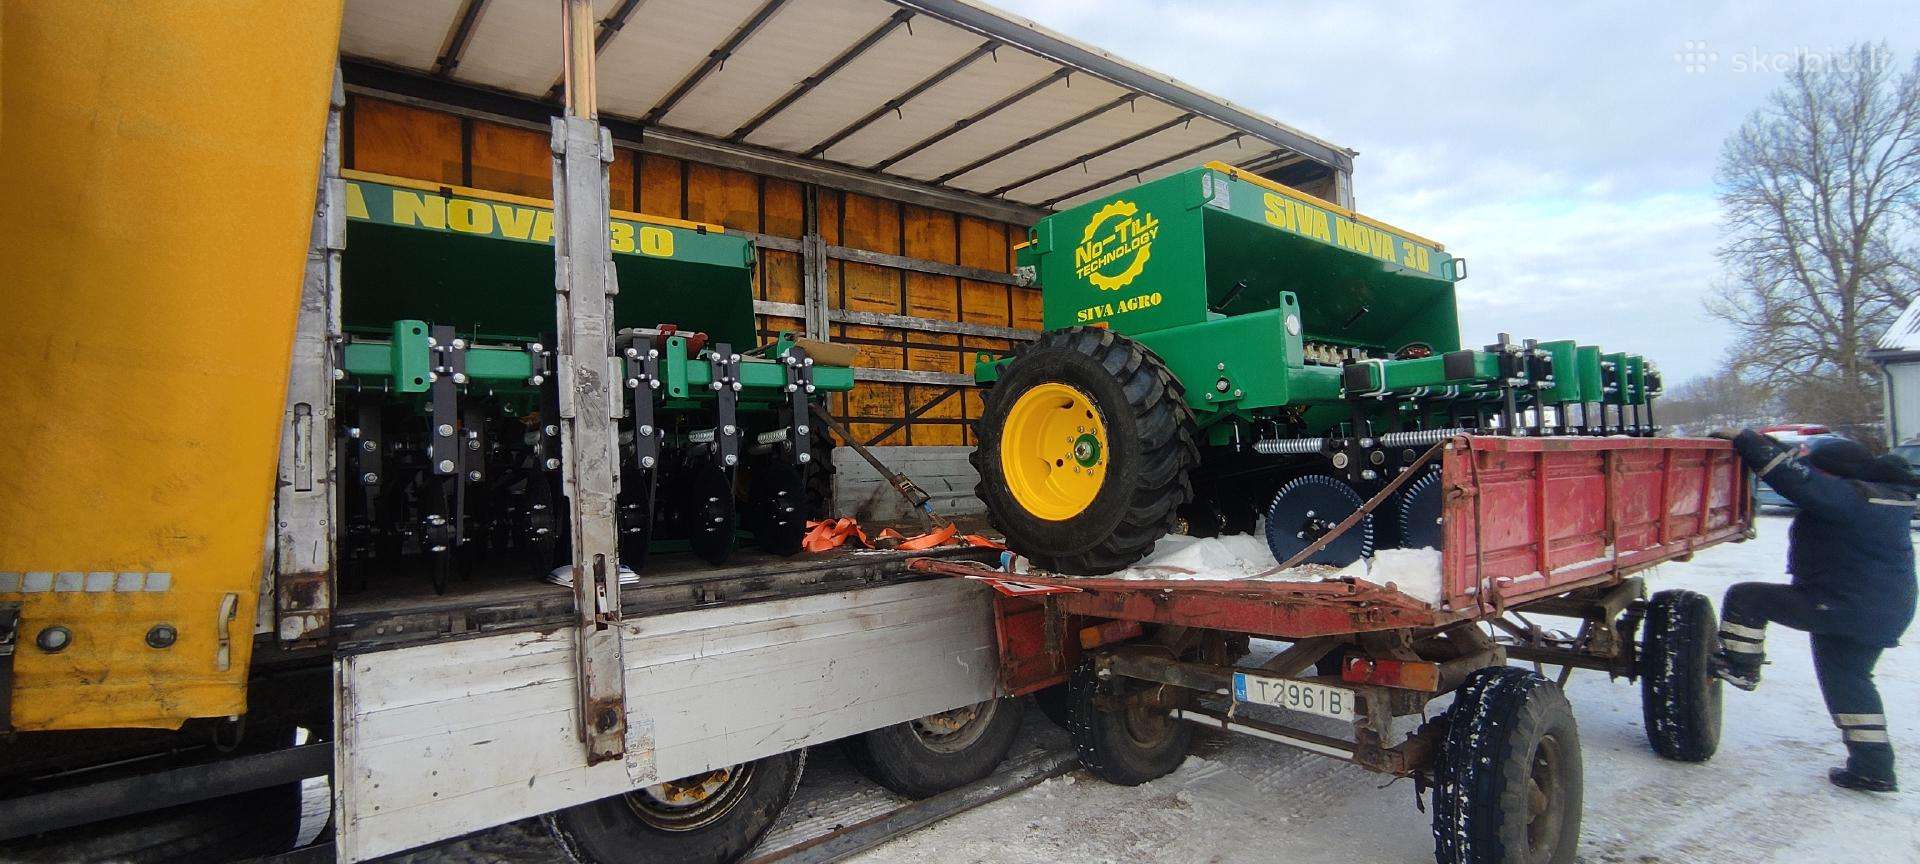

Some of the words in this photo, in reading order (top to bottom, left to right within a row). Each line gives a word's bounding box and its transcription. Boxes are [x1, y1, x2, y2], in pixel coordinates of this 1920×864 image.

[610, 221, 674, 257] 3.0
[1263, 193, 1331, 242] SIVA
[1336, 217, 1397, 263] NOVA
[1076, 226, 1160, 280] TECHNOLOGY
[1077, 303, 1114, 323] SIVA
[1117, 292, 1162, 314] AGRO
[1256, 680, 1342, 715] T2961B
